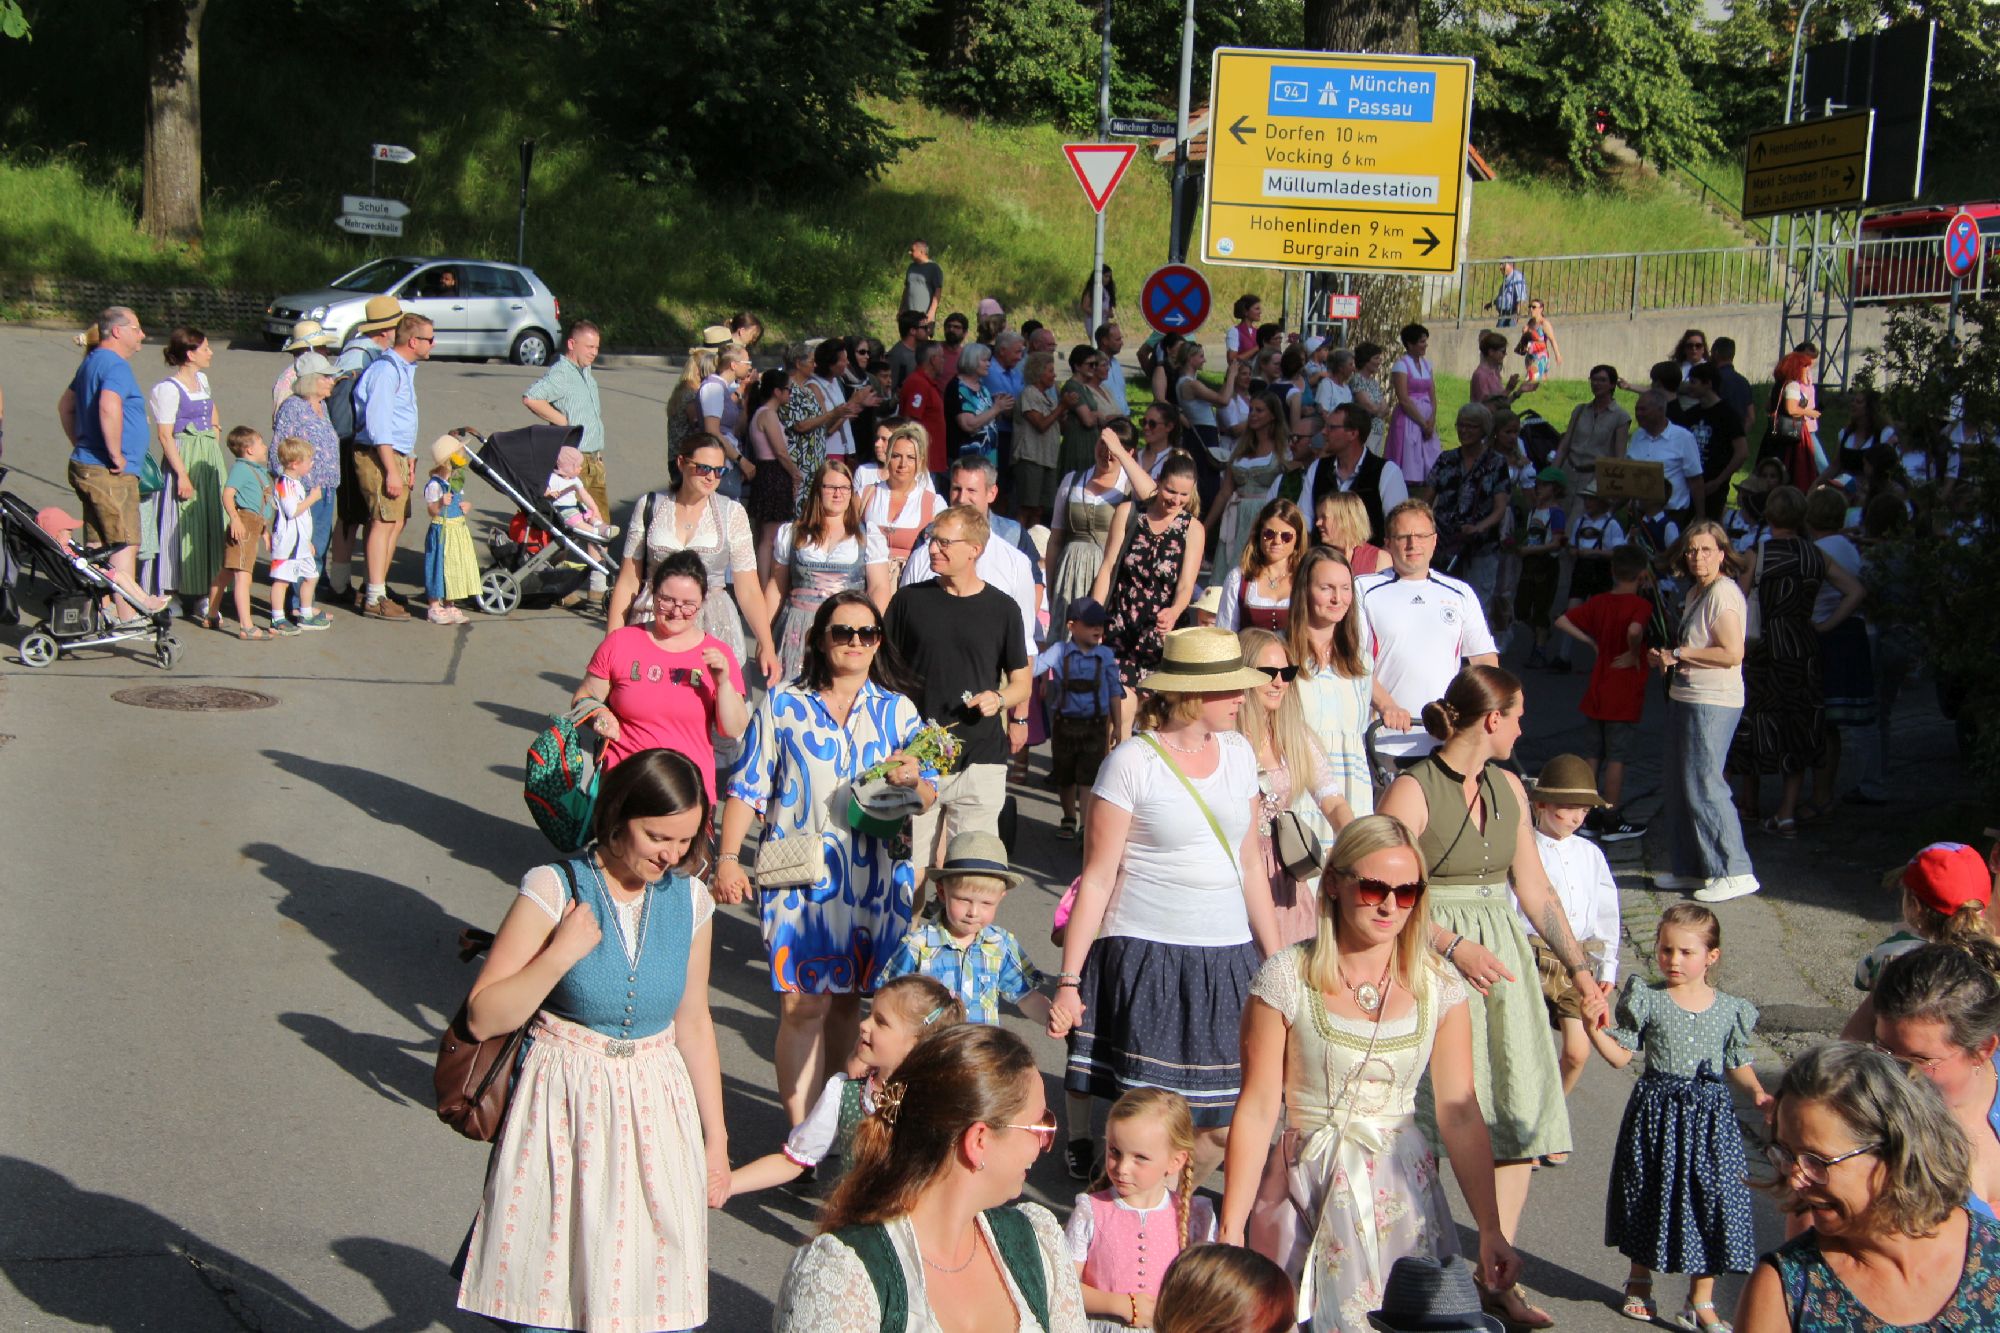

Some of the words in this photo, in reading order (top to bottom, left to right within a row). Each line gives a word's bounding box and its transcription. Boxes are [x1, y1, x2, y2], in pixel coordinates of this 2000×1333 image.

[1283, 85, 1299, 99] 94
[1349, 75, 1430, 95] München
[1348, 98, 1412, 117] Passau
[1113, 121, 1148, 132] Münchner
[1151, 124, 1175, 134] Straße
[1265, 123, 1325, 142] Dorfen
[1336, 126, 1353, 143] 10
[1358, 131, 1378, 144] km
[1769, 138, 1817, 155] Hohenlinden
[1265, 146, 1333, 169] Vocking
[1342, 150, 1351, 166] 6
[1355, 154, 1376, 167] km
[1267, 175, 1433, 199] Müllumladestation
[1753, 175, 1776, 190] Markt
[1777, 169, 1818, 187] Schwaben
[359, 201, 389, 213] Schule
[1753, 194, 1773, 209] Buch
[345, 218, 399, 232] Mehrzweckhalle
[1250, 215, 1361, 236] Hohenlinden
[1369, 220, 1380, 236] 9
[1383, 224, 1404, 237] km
[1282, 239, 1360, 261] Burgrain
[1368, 243, 1378, 259] 2
[1381, 246, 1403, 260] km
